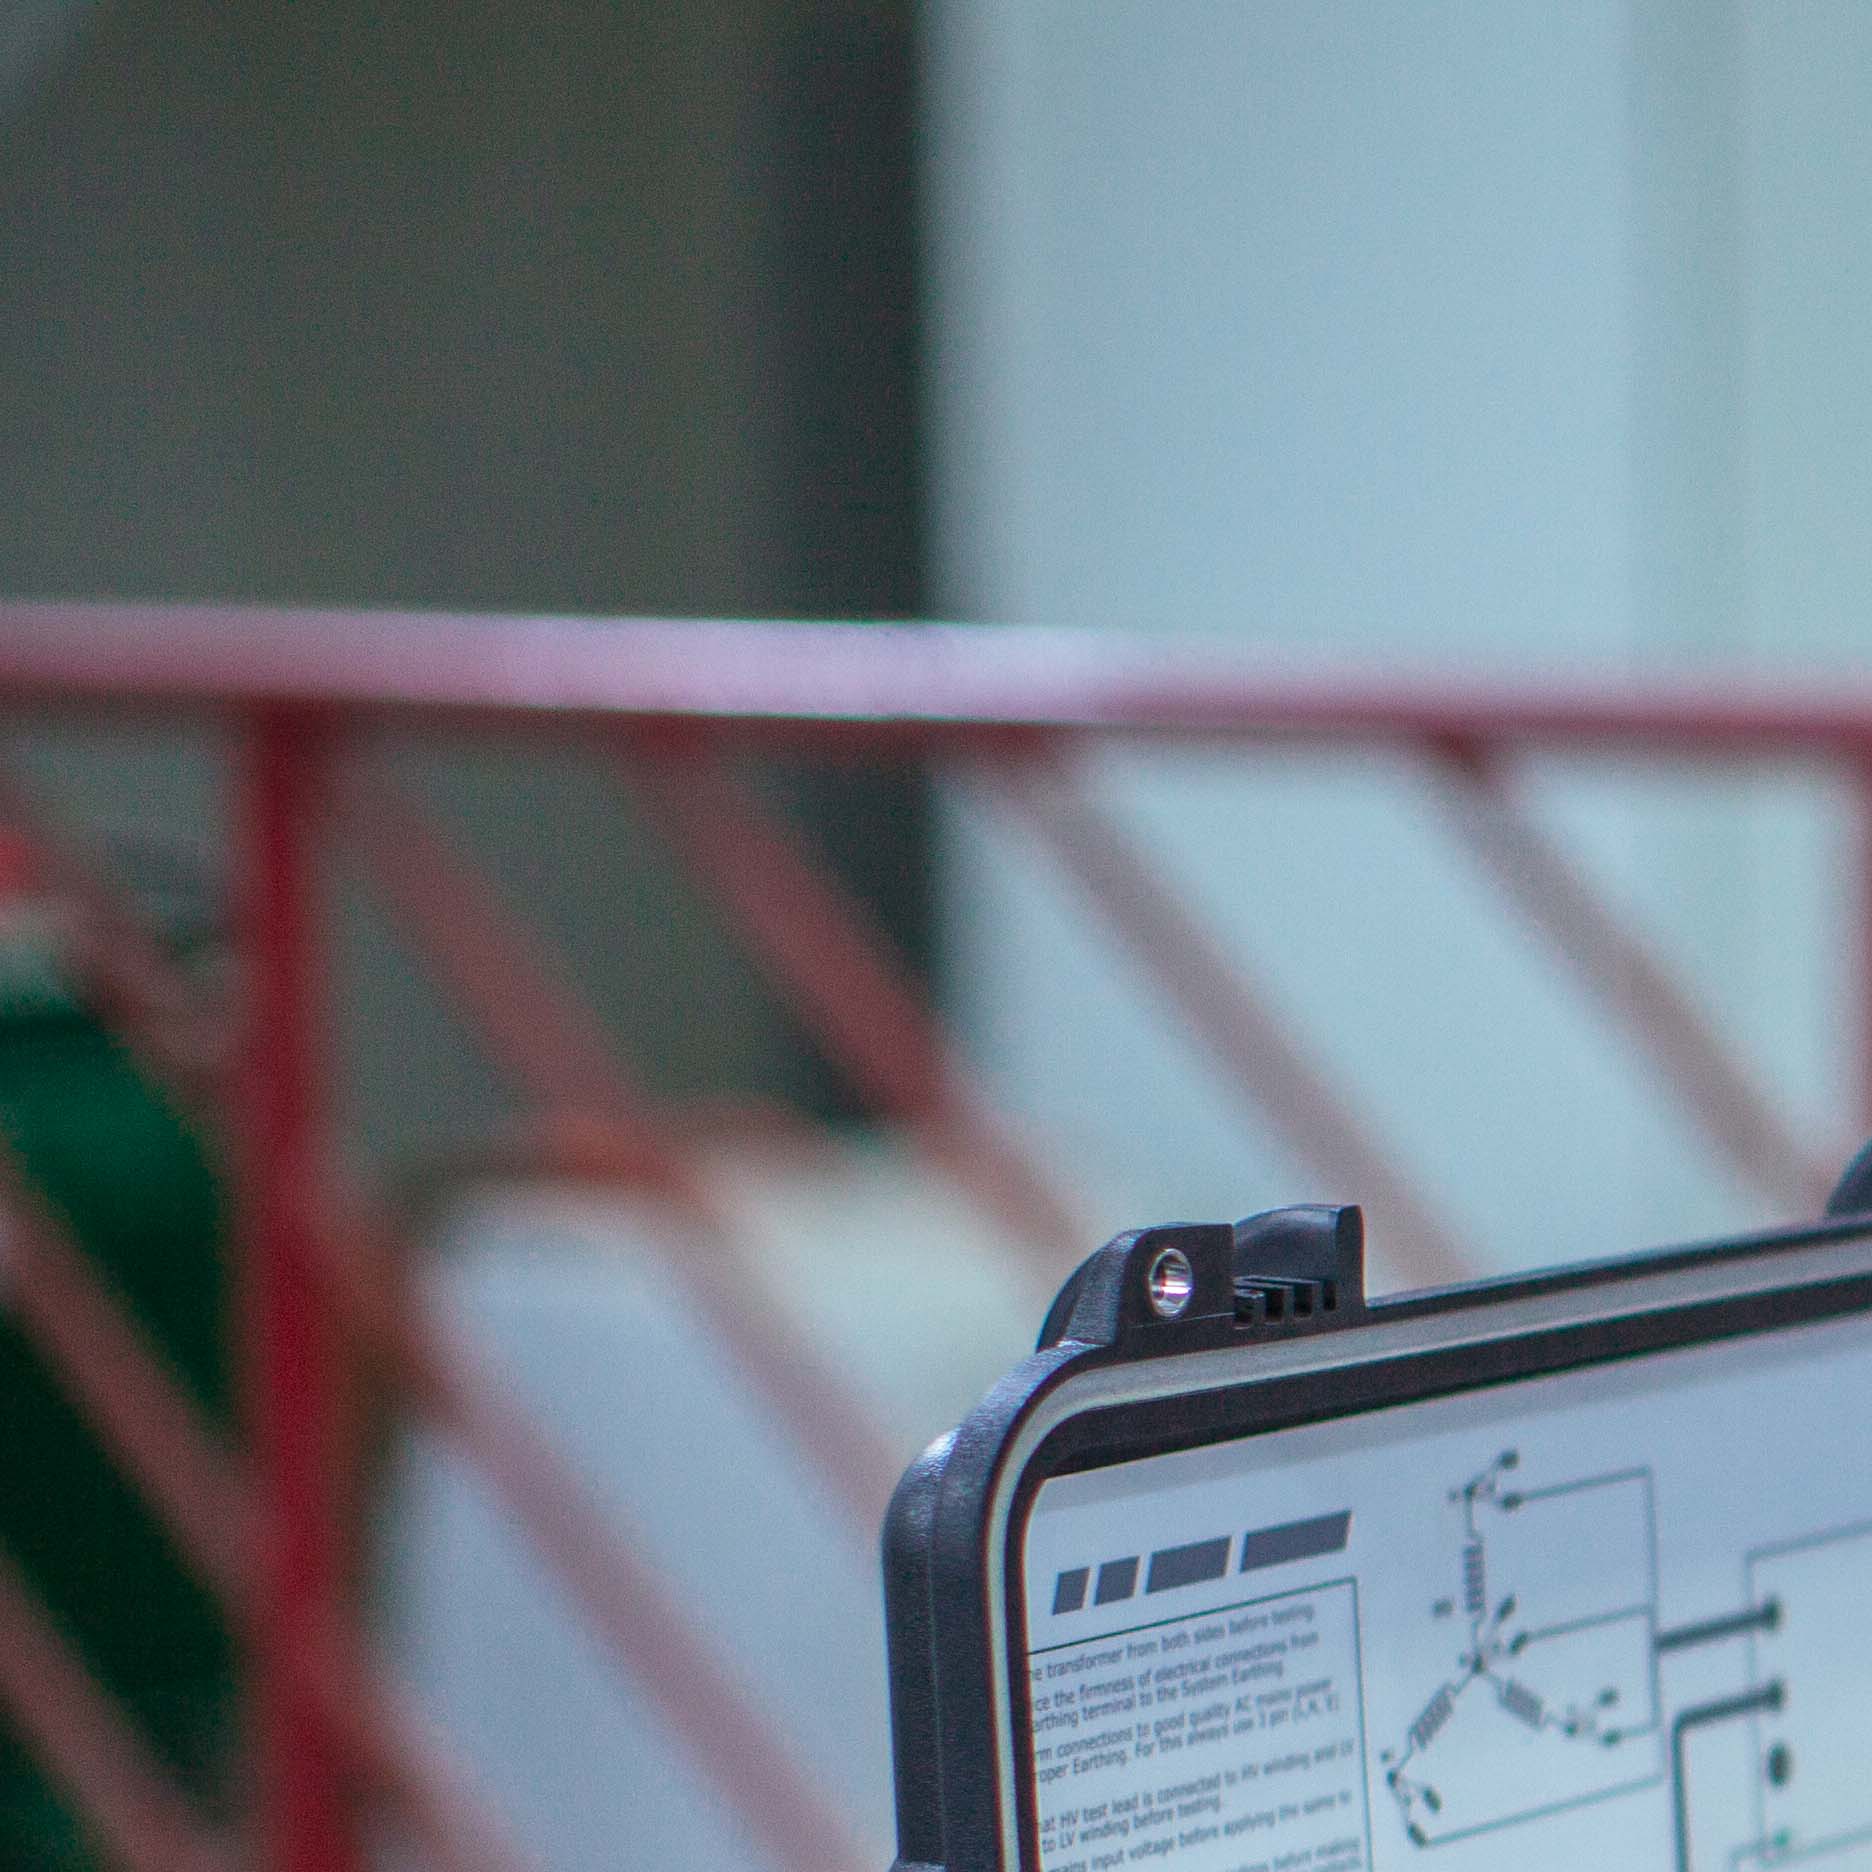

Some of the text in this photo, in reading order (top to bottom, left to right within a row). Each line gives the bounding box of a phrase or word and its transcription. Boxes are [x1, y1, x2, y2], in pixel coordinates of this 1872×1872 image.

[1047, 1650, 1122, 1677] transformer
[1126, 1642, 1157, 1659] from
[1162, 1632, 1190, 1652] both
[1054, 1690, 1075, 1706] the
[1079, 1677, 1134, 1698] firmness
[1155, 1657, 1210, 1683] electrical
[1214, 1640, 1287, 1666] connections
[1082, 1698, 1134, 1722] terminal
[1156, 1685, 1177, 1703] the
[1057, 1726, 1133, 1759] connections
[1154, 1712, 1186, 1735] good
[1189, 1703, 1231, 1727] quality
[1135, 1741, 1156, 1759] For
[1159, 1733, 1183, 1753] this
[1060, 1809, 1081, 1827] HV
[1083, 1802, 1108, 1821] test
[1112, 1792, 1139, 1815] lead
[1156, 1772, 1222, 1804] connected
[1059, 1831, 1077, 1849] LV
[1079, 1818, 1130, 1843] winding
[1133, 1807, 1175, 1831] before
[1091, 1849, 1125, 1872] input
[1129, 1836, 1175, 1860] voltage
[1178, 1824, 1219, 1848] before
[1223, 1809, 1277, 1836] applying
